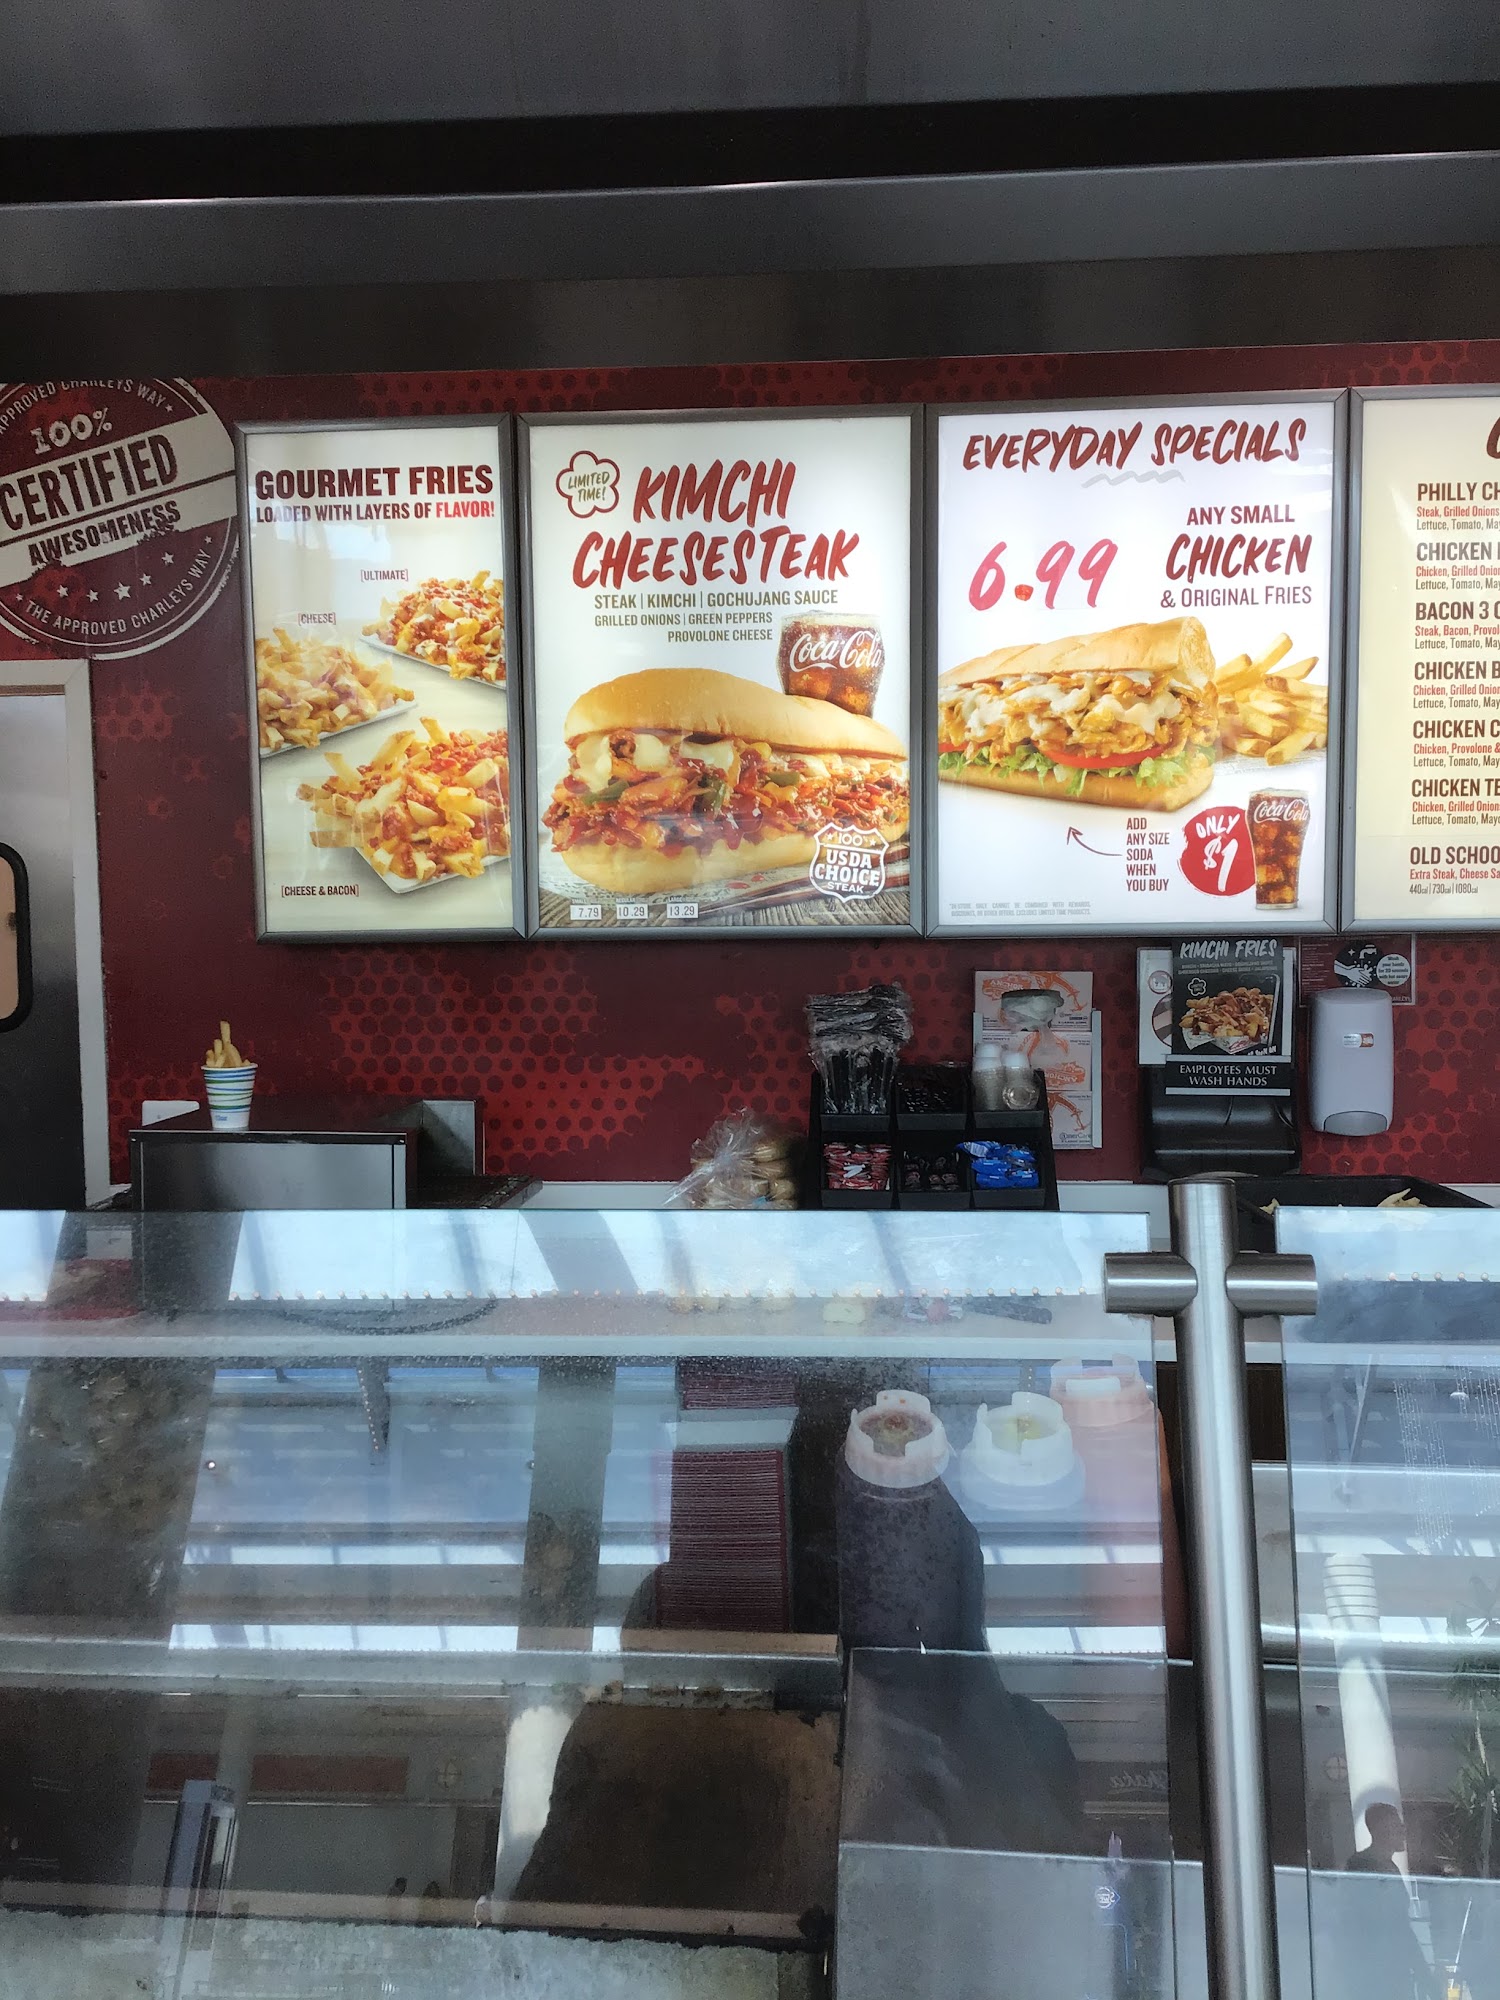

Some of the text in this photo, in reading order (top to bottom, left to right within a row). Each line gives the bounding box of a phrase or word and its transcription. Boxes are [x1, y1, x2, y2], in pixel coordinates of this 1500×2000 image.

[0, 381, 57, 434] APPROVED
[136, 383, 167, 408] WAY
[30, 407, 113, 454] 100%
[962, 418, 1306, 473] EVERYDAY SPECIALS
[0, 434, 178, 531] CERTIFIED
[255, 464, 493, 500] GOURMET FRIES
[567, 471, 610, 490] LIMITED
[578, 486, 607, 503] TIME!
[633, 458, 796, 528] KIMCHI
[1417, 482, 1477, 501] PHILLY
[256, 500, 495, 523] LOADED WITH LAYERS OF FLAVOR!
[1186, 504, 1295, 526] ANY SMALL
[1416, 506, 1442, 518] Steak,
[1444, 506, 1470, 517] Grilled
[27, 500, 181, 567] AWESOMENESS
[1416, 519, 1449, 531] Lettuce,
[1451, 519, 1484, 530] Tomato,
[572, 525, 860, 591] CHEESESTEAK
[1165, 533, 1312, 583] CHICKEN
[1416, 542, 1492, 561] CHICKEN
[968, 539, 1119, 611] 6.99
[1416, 566, 1449, 577] Chicken,
[1452, 565, 1478, 576] Grilled
[26, 547, 213, 636] THE APPROVED CHARLEYS WAY
[1416, 579, 1448, 590] Lettuce,
[1451, 578, 1483, 590] Tomato,
[594, 589, 839, 609] STEAK KIMCHI GOCHUJANG SAUCE
[1160, 585, 1312, 608] & ORIGINAL FRIES
[594, 611, 773, 627] GRILLED ONIONS GREEN PEPPERS
[1415, 601, 1474, 621] BACON
[1479, 601, 1489, 619] 3
[667, 629, 773, 643] PROVOLONE CHEESE
[1415, 625, 1441, 637] Steak,
[1443, 625, 1471, 637] Bacon,
[789, 630, 882, 673] Coca-Cola
[1415, 638, 1448, 650] Lettuce,
[1450, 637, 1482, 649] Tomato,
[1414, 661, 1487, 680] CHICKEN
[1413, 685, 1448, 696] Chicken,
[1450, 684, 1476, 695] Grilled
[1413, 698, 1446, 709] Lettuce,
[1449, 697, 1481, 709] Tomato,
[1413, 720, 1485, 739] CHICKEN
[1413, 743, 1449, 755] Chicken,
[1451, 743, 1492, 754] Provolone
[1413, 756, 1446, 768] Lettuce,
[1449, 756, 1481, 767] Tomato,
[1412, 779, 1480, 797] CHICKEN
[1253, 799, 1309, 823] Coca-Cola
[1412, 801, 1500, 813] Chicken, Grilled Onion
[1126, 817, 1147, 830] ADD
[1195, 814, 1240, 839] ONLY
[1412, 814, 1444, 826] Lettuce,
[1447, 814, 1478, 825] Tomato,
[1126, 832, 1170, 846] ANY SIZE
[826, 849, 872, 869] USDA
[1126, 848, 1153, 861] SODA
[1410, 846, 1500, 865] OLD SCHOO
[1126, 864, 1156, 876] WHEN
[1203, 835, 1239, 893] $1
[814, 863, 880, 887] CHOICE
[1410, 869, 1431, 880] Extra
[1433, 869, 1457, 880] Steak,
[1459, 868, 1488, 879] Cheese
[318, 885, 326, 896] &
[827, 882, 865, 893] STEAK
[1126, 879, 1169, 892] YOU BUY
[1410, 884, 1428, 894] 440cal
[1432, 884, 1451, 894] 730cal
[578, 908, 599, 918] 7.79
[618, 907, 645, 917] 10.29
[669, 905, 695, 916] 13.29
[1179, 939, 1277, 960] KIMCHI FRIES
[1180, 1064, 1277, 1075] EMPLOYEES MUST
[1189, 1076, 1267, 1086] WASH HANDS
